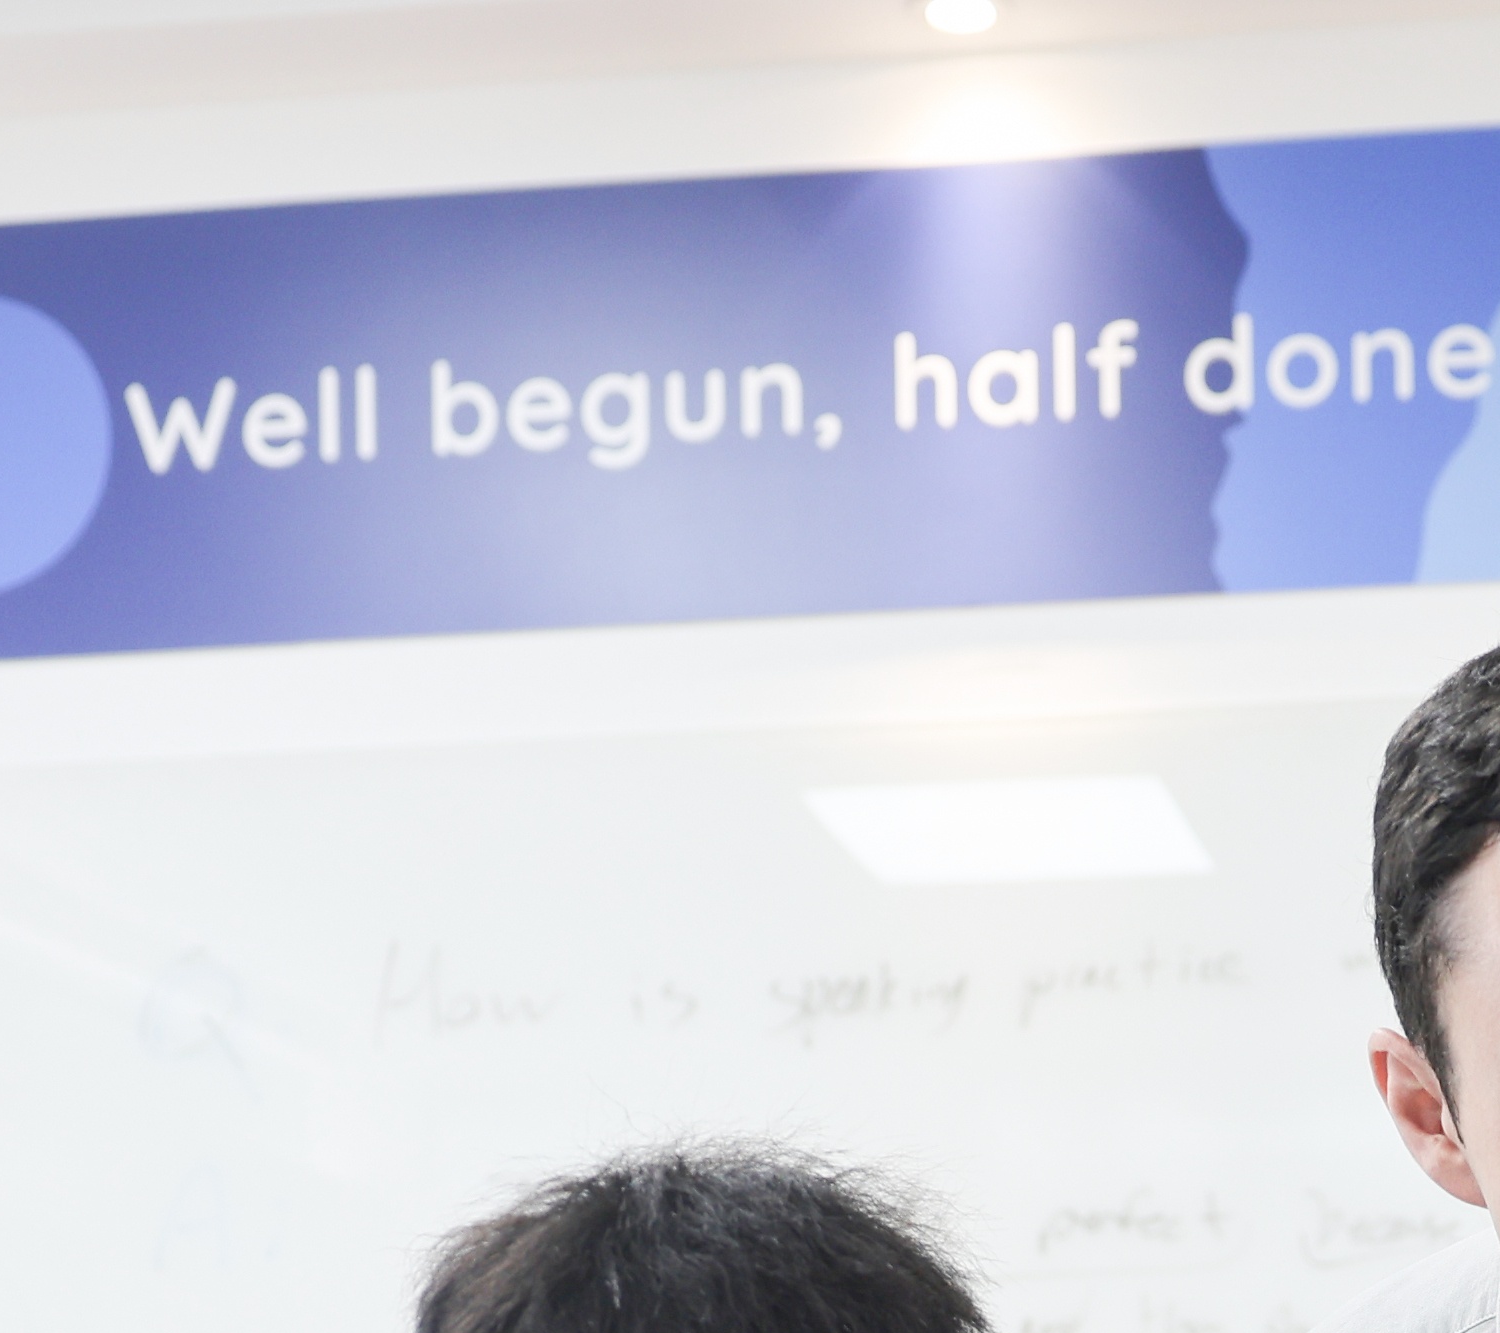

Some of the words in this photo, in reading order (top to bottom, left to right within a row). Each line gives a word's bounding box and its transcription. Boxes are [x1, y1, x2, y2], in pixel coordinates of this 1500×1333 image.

[124, 362, 377, 475] Well
[430, 357, 843, 471] begun,
[893, 318, 1140, 431] half
[1184, 311, 1495, 415] done
